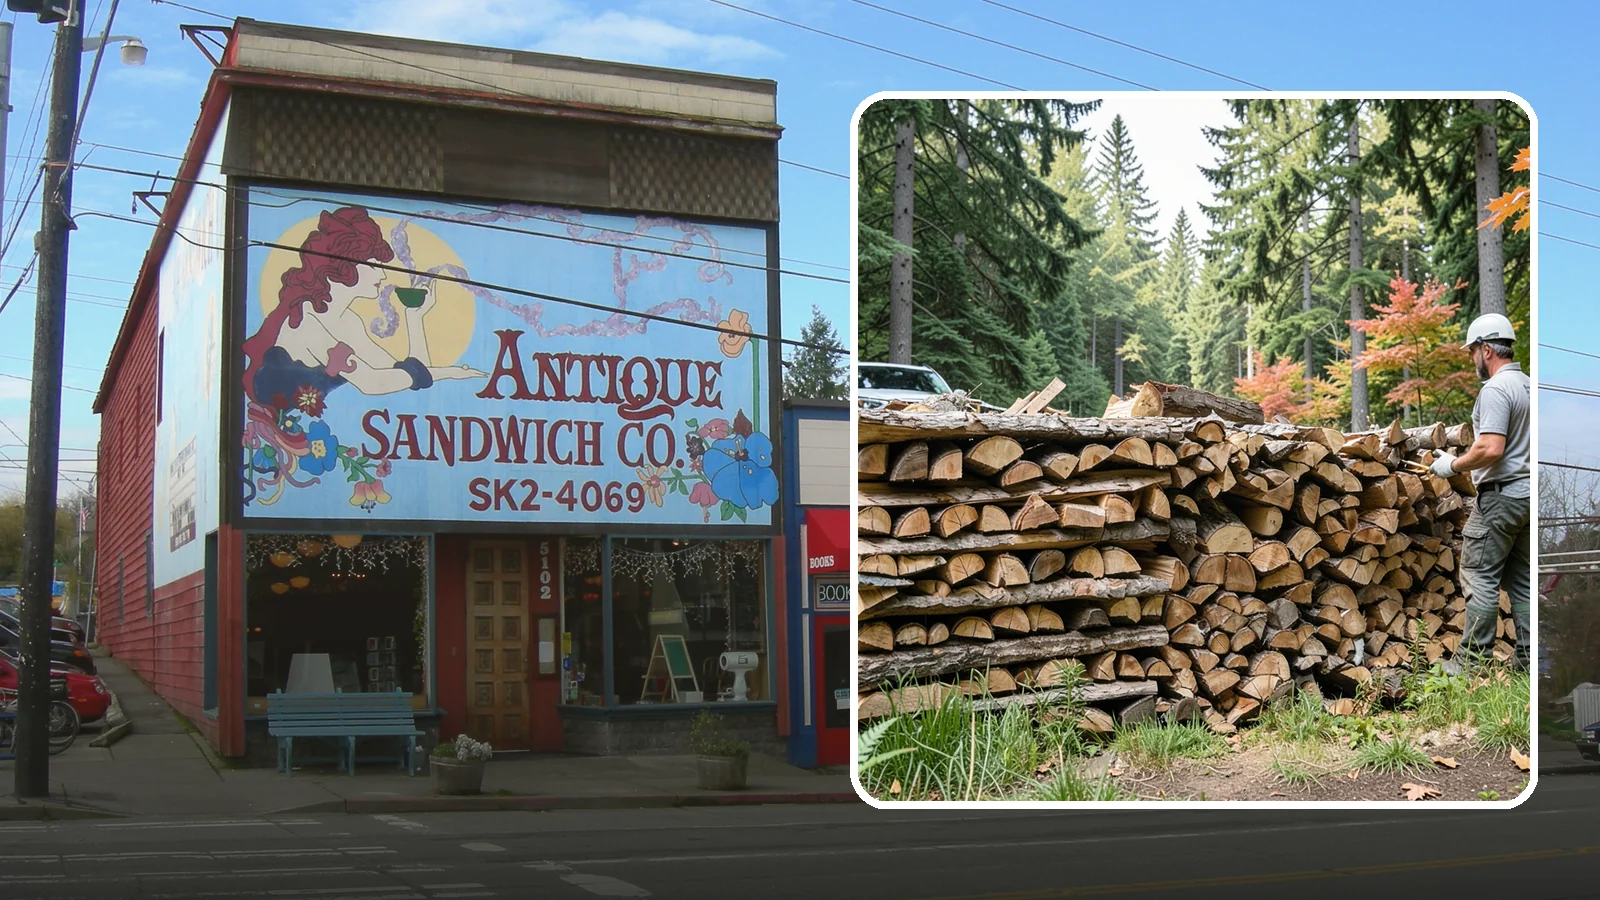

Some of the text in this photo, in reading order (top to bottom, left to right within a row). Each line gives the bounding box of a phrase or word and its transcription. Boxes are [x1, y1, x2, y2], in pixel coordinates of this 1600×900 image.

[476, 329, 723, 421] ANTIQUE
[361, 408, 685, 468] SANDWICH CO.
[468, 477, 646, 512] SK2-4069
[540, 541, 551, 599] 5102
[809, 555, 834, 568] BOOKS
